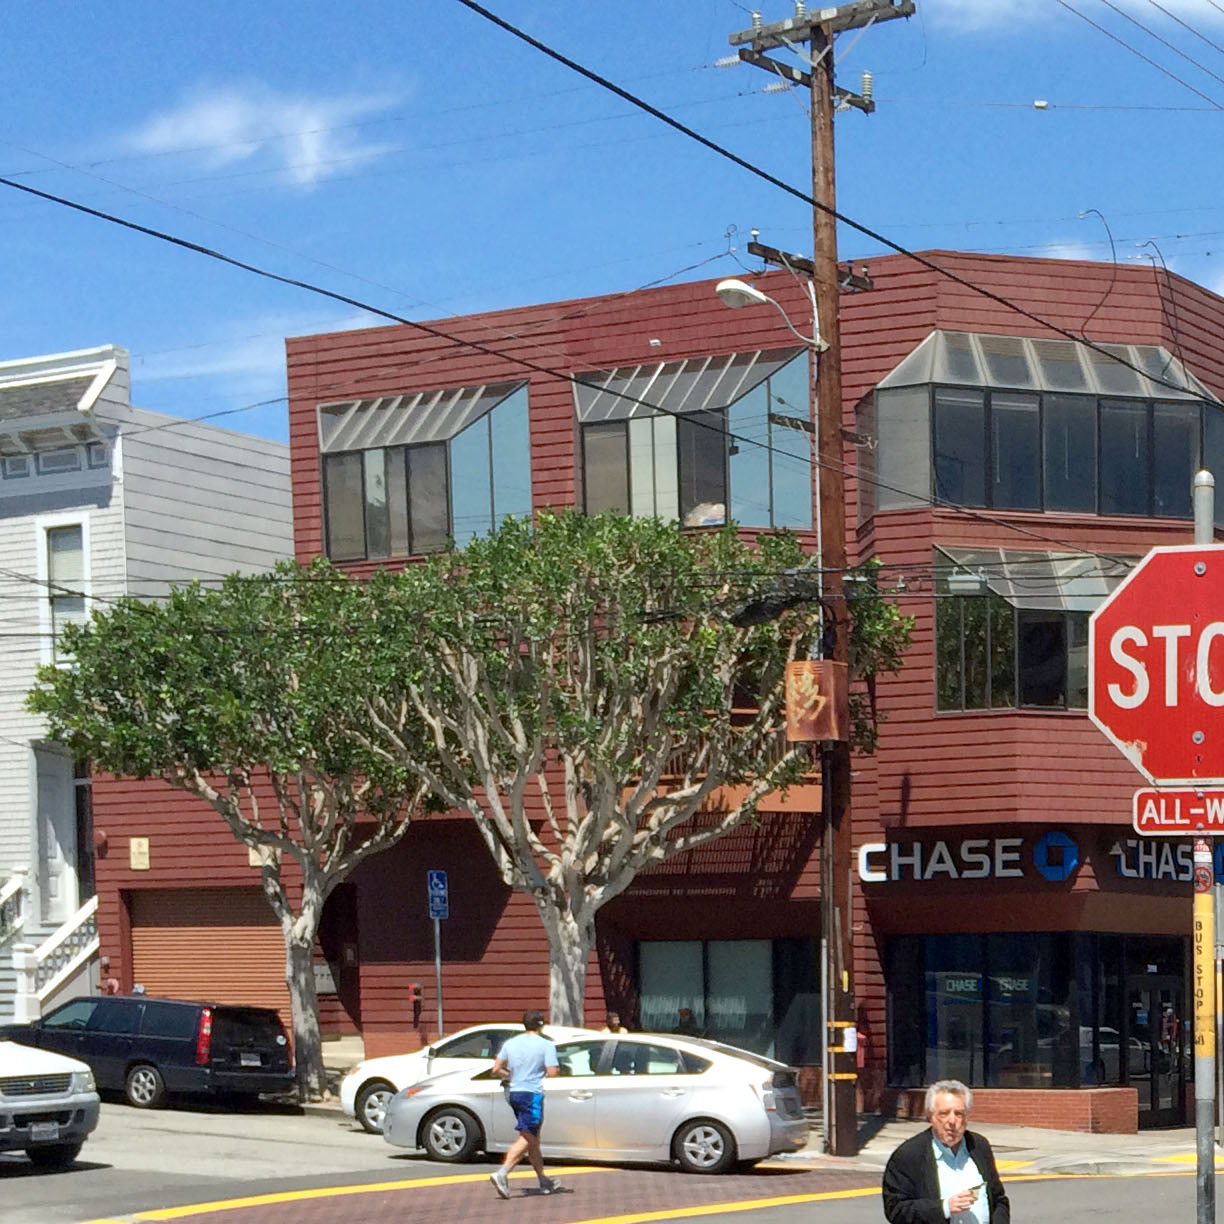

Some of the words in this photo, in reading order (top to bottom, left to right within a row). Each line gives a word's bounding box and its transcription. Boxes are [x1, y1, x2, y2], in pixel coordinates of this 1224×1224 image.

[858, 838, 1024, 882] CHASE
[1117, 839, 1194, 882] CHAS
[1195, 920, 1203, 955] BUS
[946, 979, 977, 992] CHASE
[1196, 964, 1204, 1010] STOP
